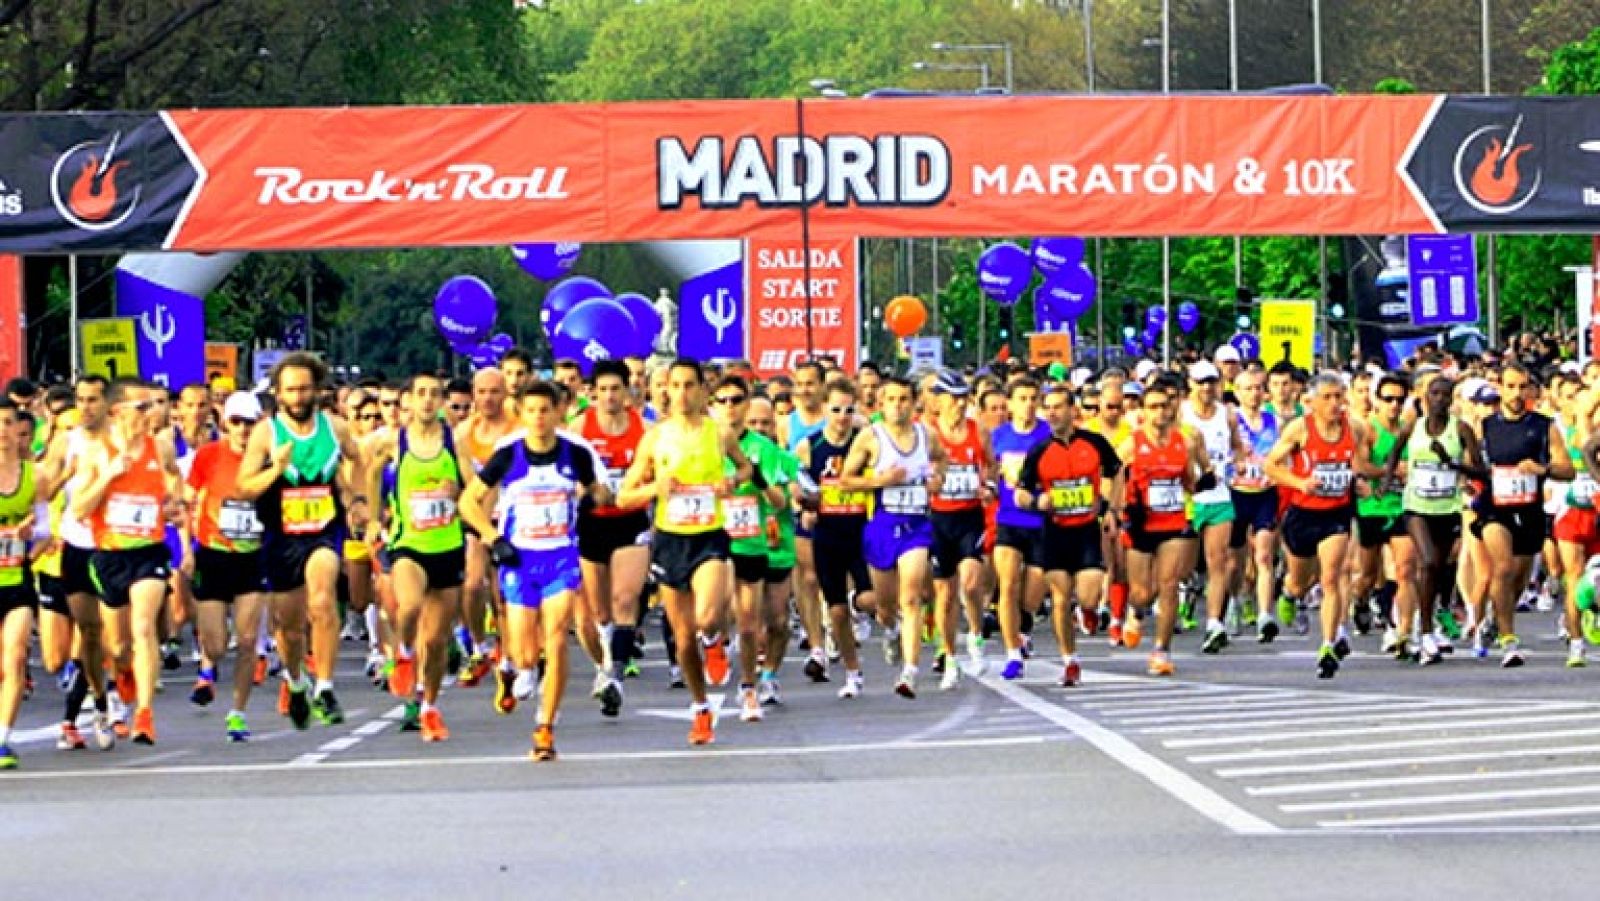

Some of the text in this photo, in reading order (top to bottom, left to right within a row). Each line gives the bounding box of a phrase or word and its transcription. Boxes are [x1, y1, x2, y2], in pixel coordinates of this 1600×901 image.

[656, 134, 951, 210] MADRID
[972, 153, 1356, 196] MARATÓN & 10K
[758, 248, 842, 268] SALDA
[763, 278, 838, 298] START
[1281, 340, 1292, 363] 1
[105, 358, 118, 384] 1
